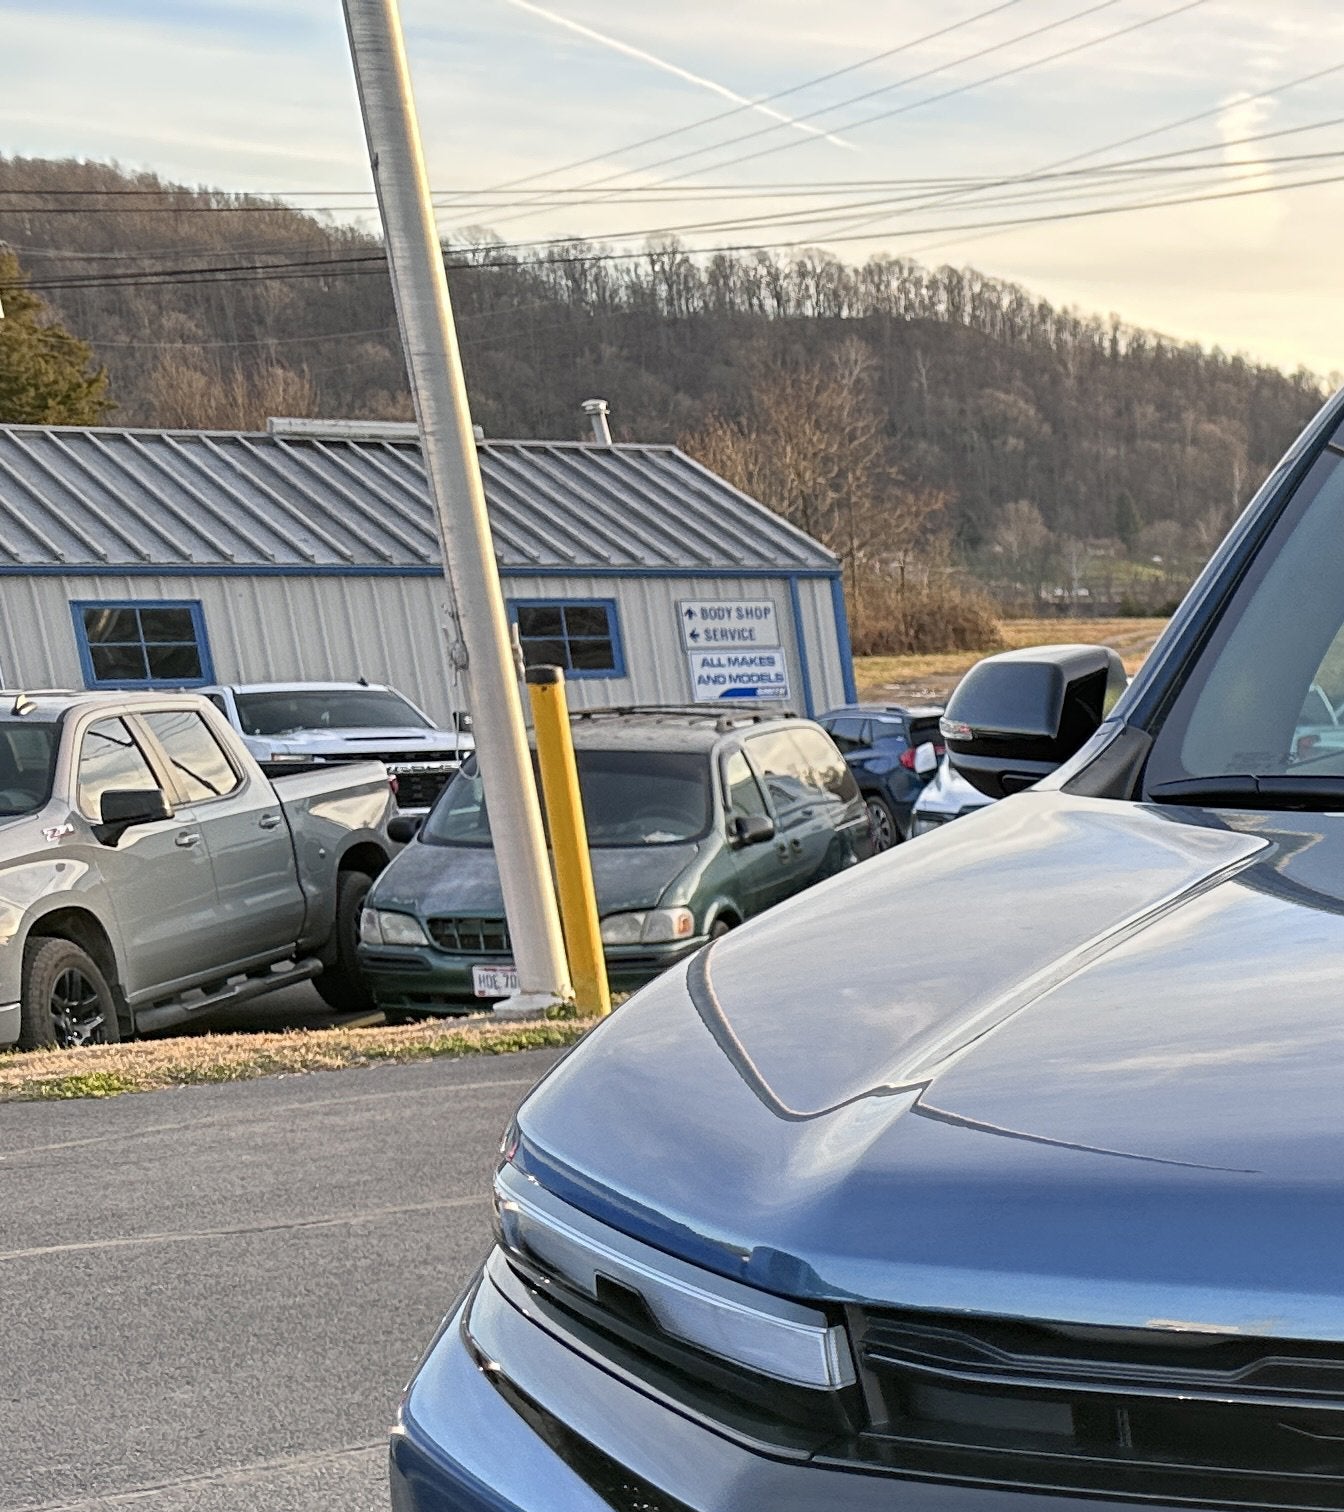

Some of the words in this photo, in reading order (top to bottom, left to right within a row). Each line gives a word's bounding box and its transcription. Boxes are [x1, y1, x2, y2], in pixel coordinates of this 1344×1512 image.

[700, 606, 732, 620] BODY
[736, 606, 771, 620] SHOP
[703, 627, 756, 641] SERVICE
[701, 656, 726, 668] ALL
[727, 656, 776, 668] MAKES
[697, 674, 727, 686] AND
[729, 673, 784, 685] MODELS
